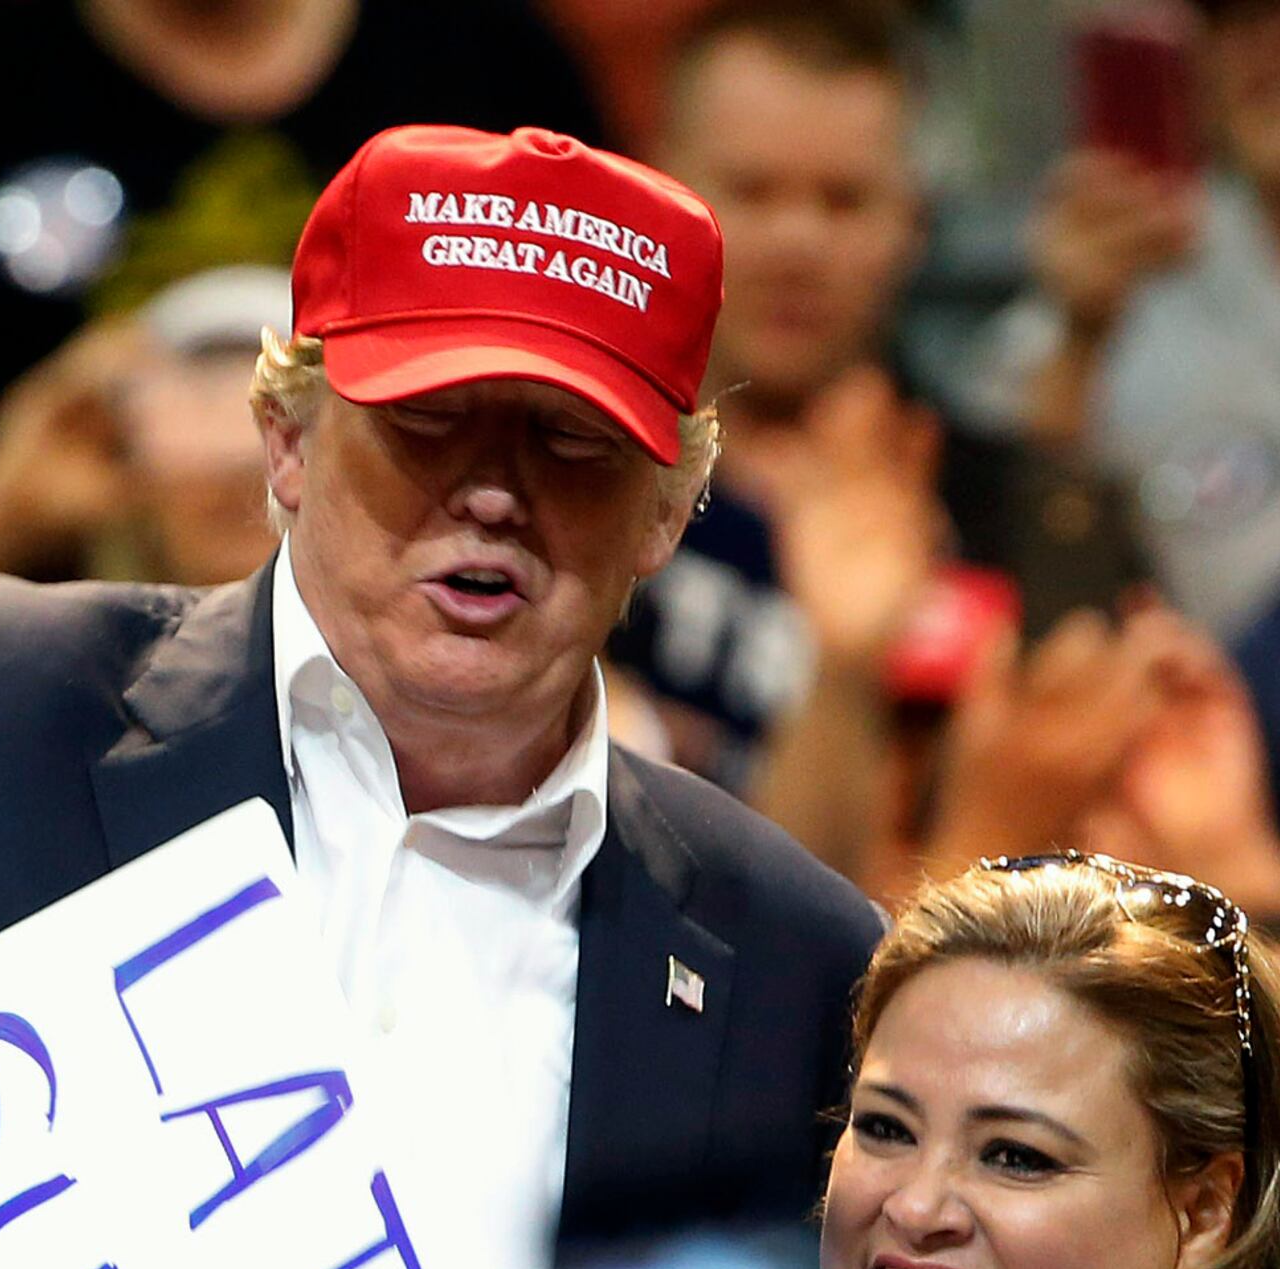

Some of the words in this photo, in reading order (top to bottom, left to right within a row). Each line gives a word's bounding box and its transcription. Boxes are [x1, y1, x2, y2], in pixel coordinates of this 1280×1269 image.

[403, 191, 514, 230] MAKE
[515, 202, 673, 280] AMERICA
[420, 233, 545, 275] GREAT
[542, 250, 653, 314] AGAIN
